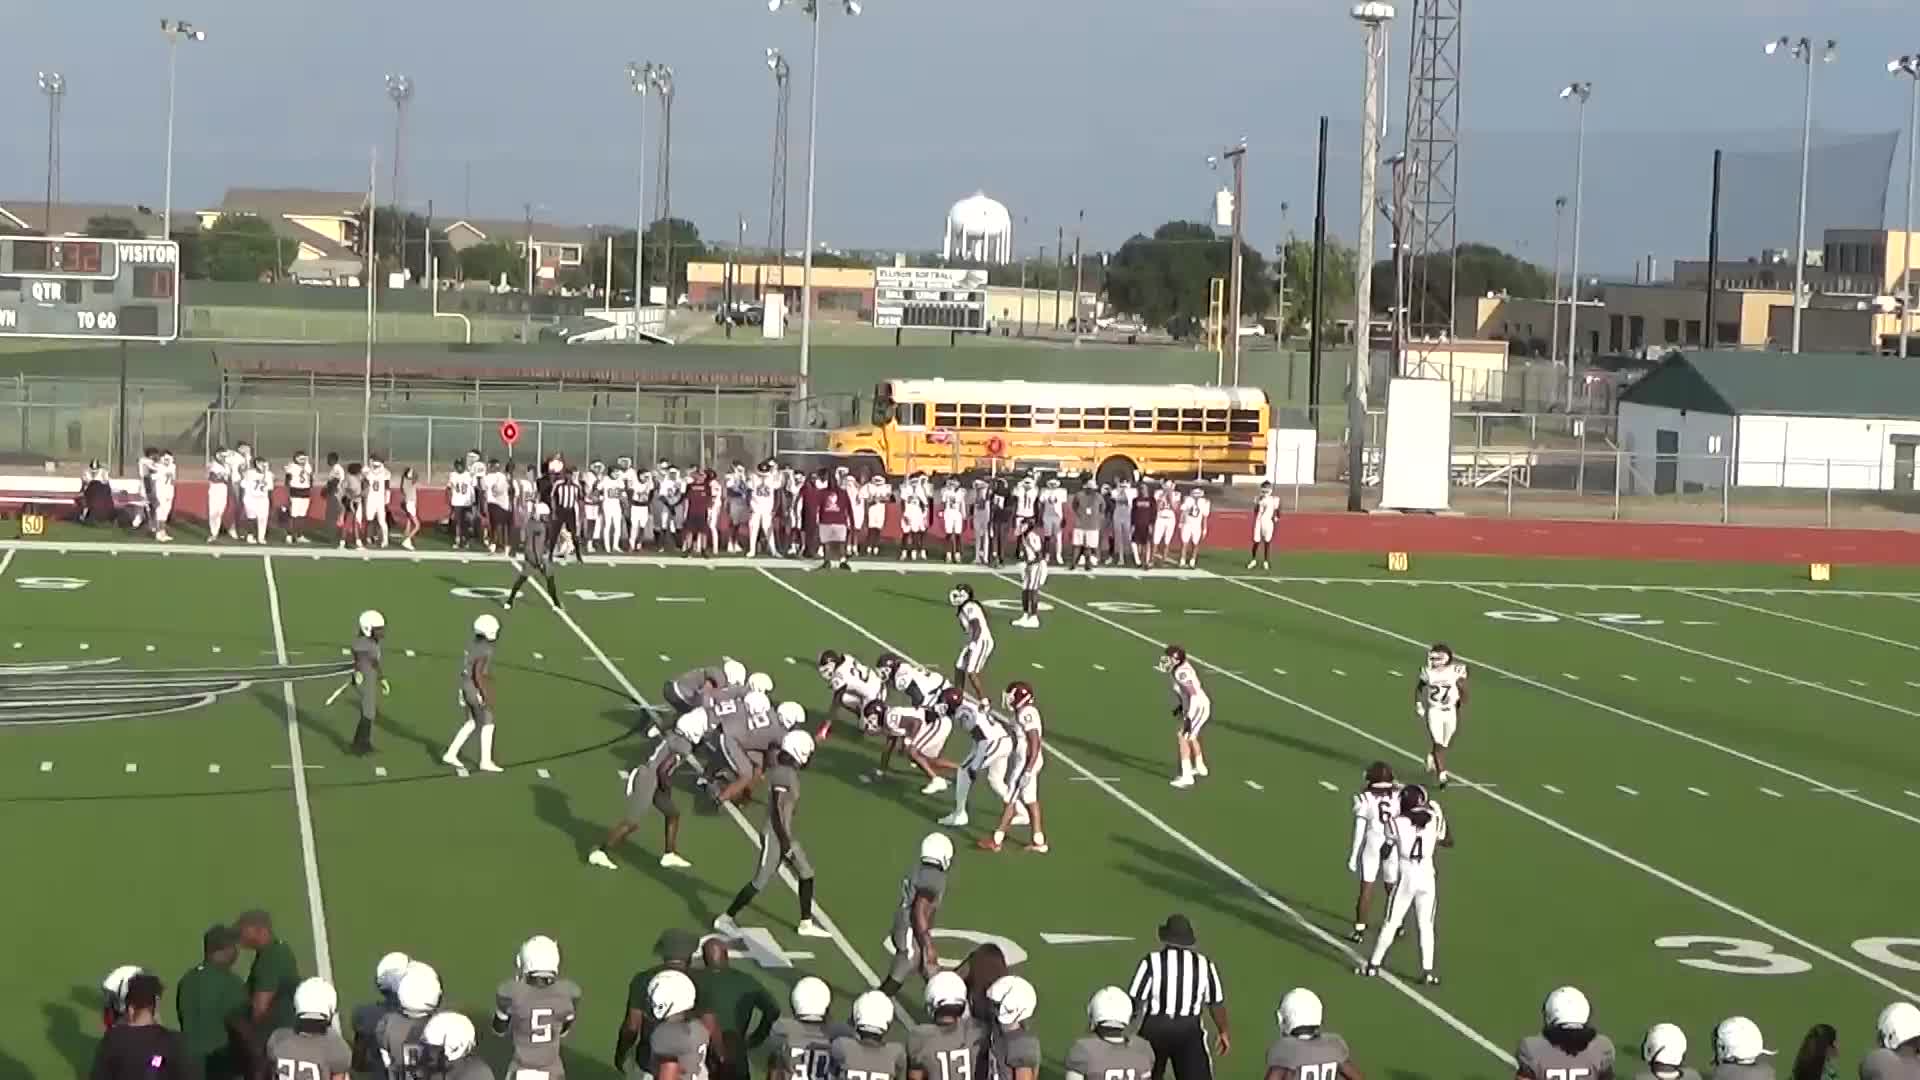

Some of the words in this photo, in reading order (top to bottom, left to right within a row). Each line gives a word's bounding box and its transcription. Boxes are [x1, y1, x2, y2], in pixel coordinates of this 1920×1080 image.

[119, 245, 176, 263] VISITOR
[32, 282, 62, 301] QTR
[77, 312, 95, 328] TO
[97, 312, 117, 329] GO
[24, 516, 41, 532] 50
[1430, 685, 1452, 703] 27
[1378, 801, 1392, 824] 6
[1409, 836, 1424, 864] 4
[530, 1008, 554, 1044] 5
[936, 1048, 971, 1080] 13
